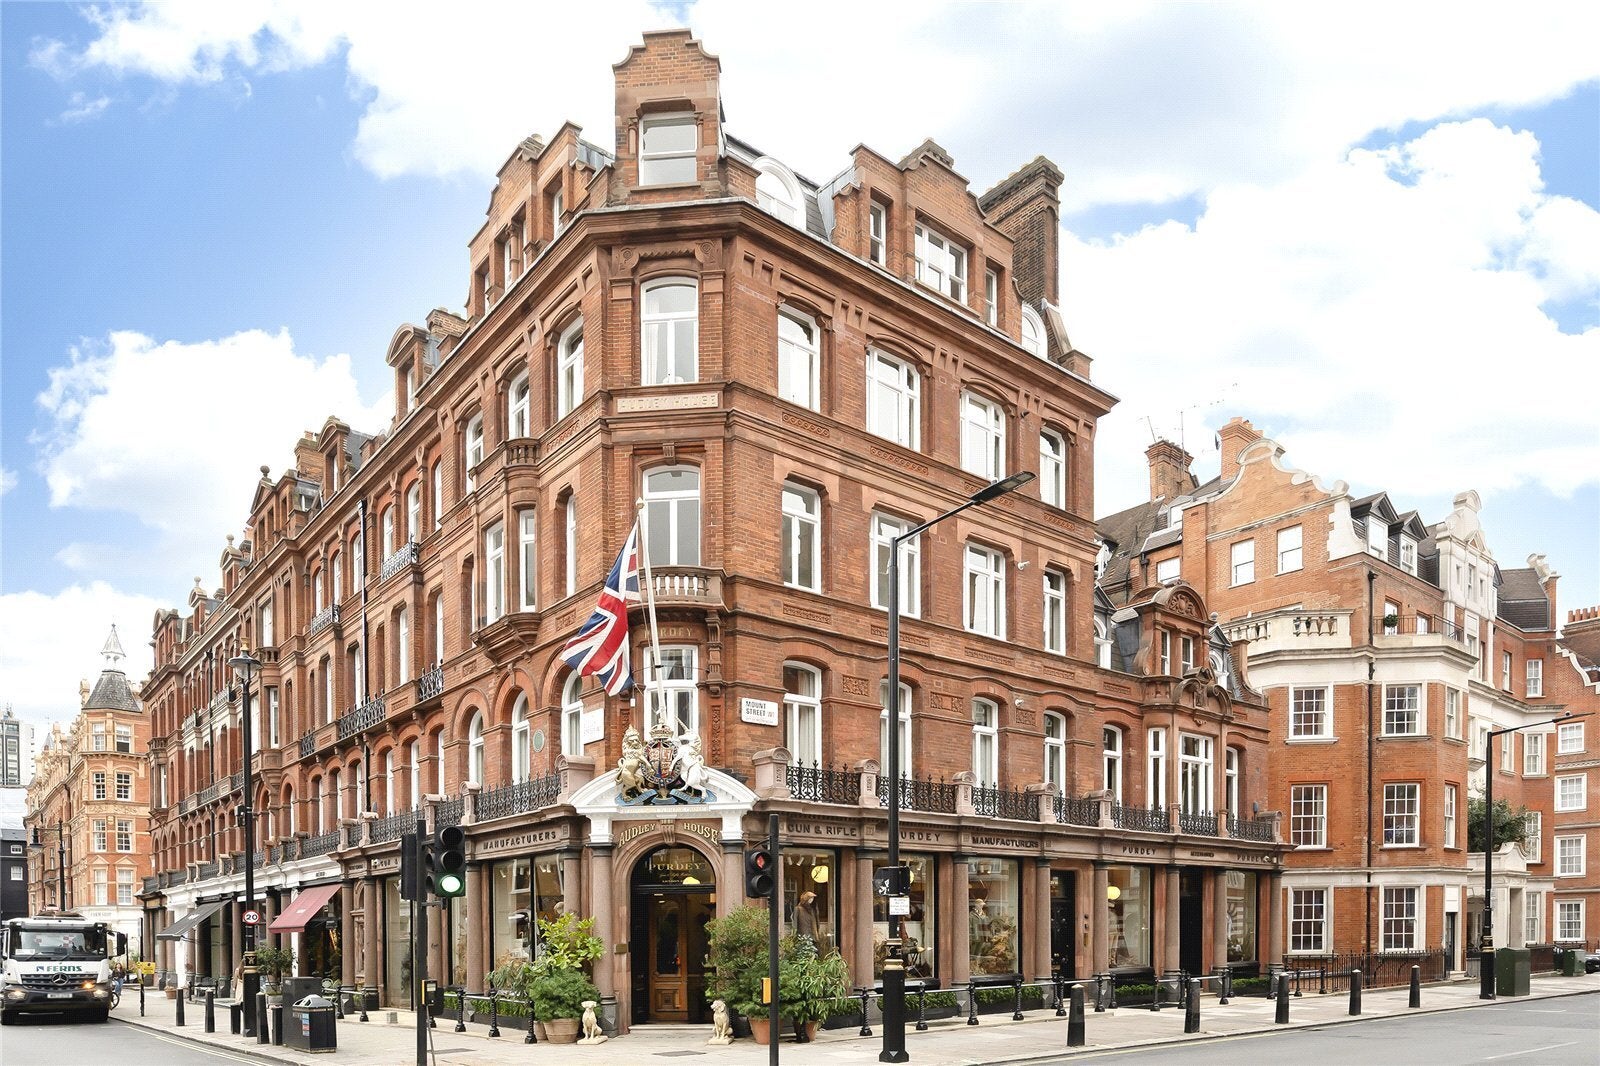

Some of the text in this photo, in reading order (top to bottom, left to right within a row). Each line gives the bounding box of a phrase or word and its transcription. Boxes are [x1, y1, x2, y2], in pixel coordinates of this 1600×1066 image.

[643, 627, 693, 639] PRDEY
[745, 700, 766, 709] MOUNT
[745, 708, 766, 717] STREET
[619, 822, 719, 848] AUDLEY HOUSE
[787, 823, 857, 837] GUN & RIFLE
[483, 830, 557, 850] MANUFACTURERS
[900, 831, 941, 842] URDEY
[972, 836, 1039, 848] MANUFACTURERS
[1122, 846, 1156, 856] PURDEY
[648, 863, 701, 871] PURDEY
[245, 913, 258, 921] 20
